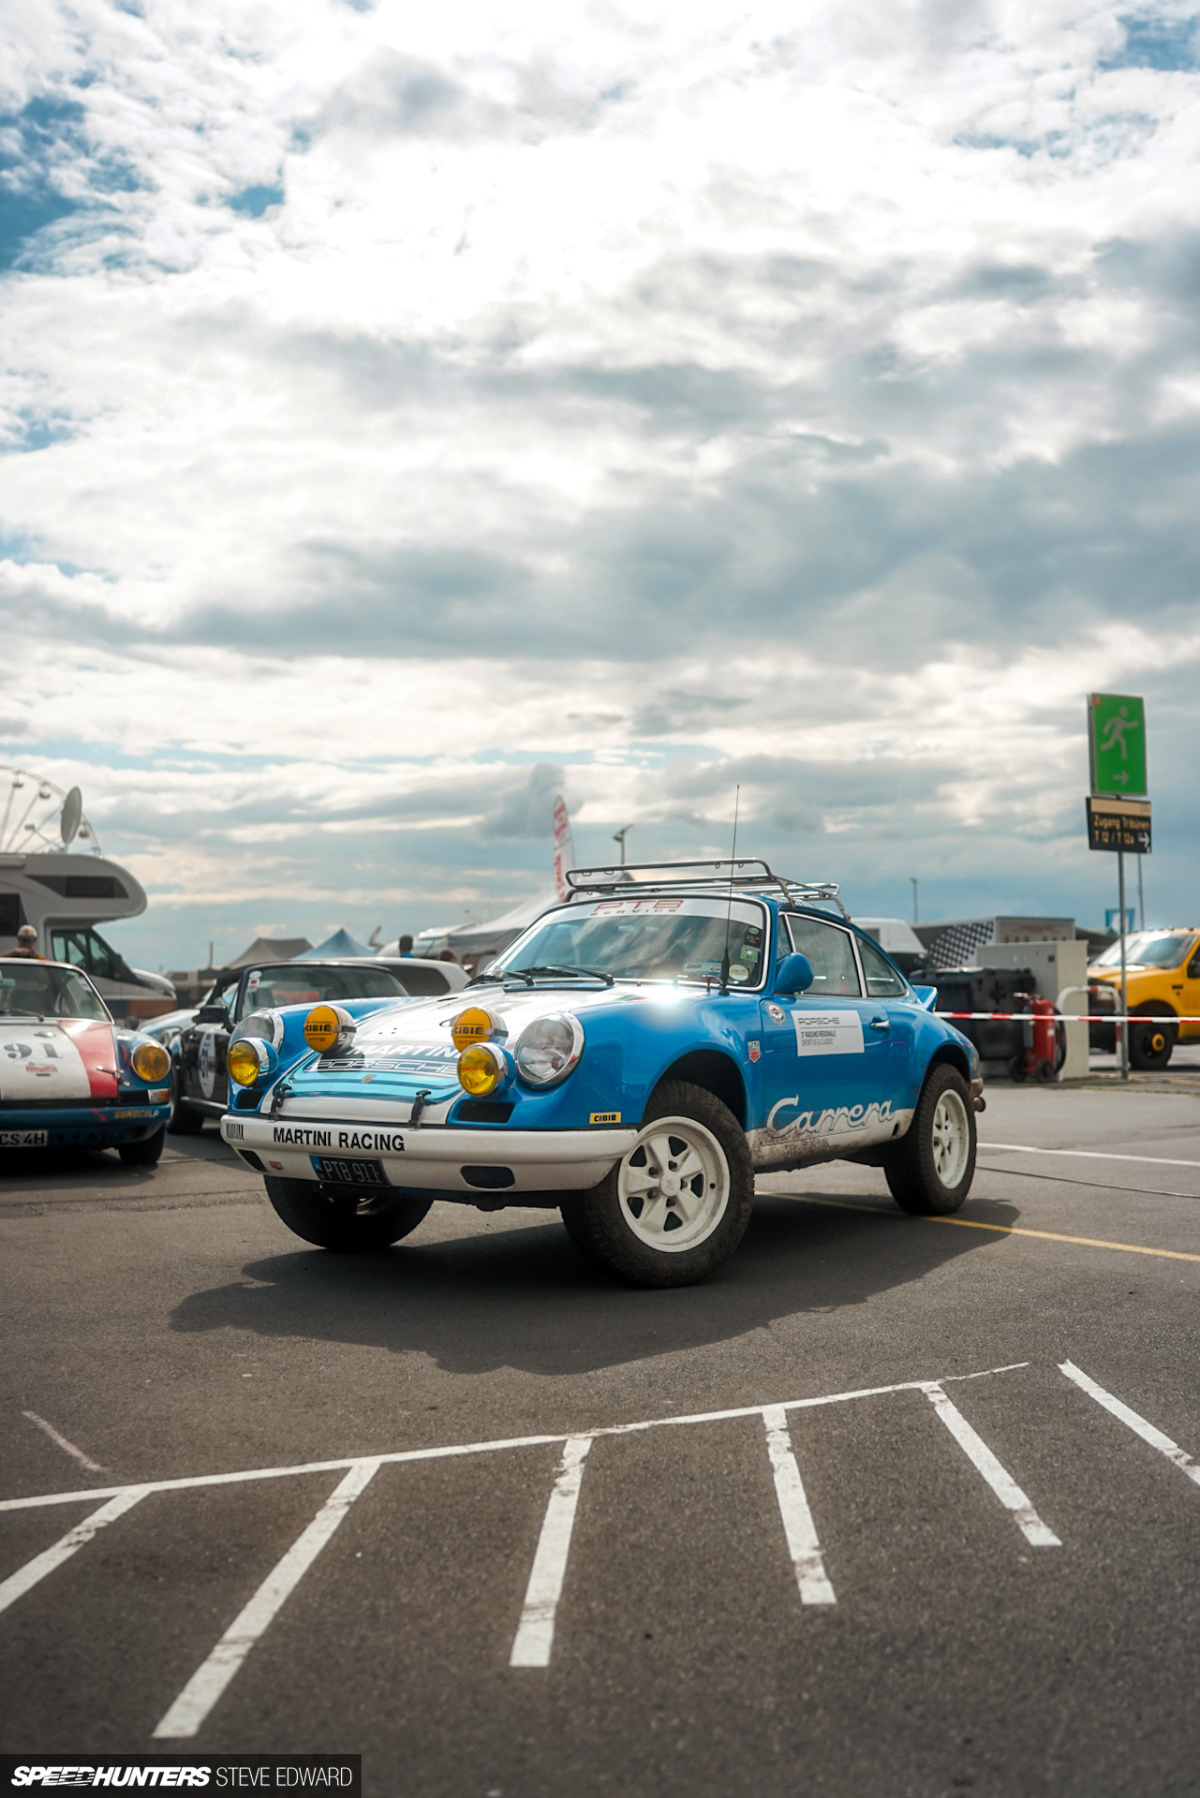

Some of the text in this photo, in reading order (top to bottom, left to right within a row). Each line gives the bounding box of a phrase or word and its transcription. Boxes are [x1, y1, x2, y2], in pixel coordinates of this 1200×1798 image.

[1094, 814, 1120, 830] Zugang
[594, 900, 684, 912] PTB
[798, 1017, 840, 1025] PORSCHE
[3, 1043, 63, 1059] 91
[766, 1094, 897, 1139] Carrera
[23, 1132, 45, 1145] 4H
[273, 1127, 405, 1151] MARTINI RACING
[322, 1160, 384, 1184] PTB 911
